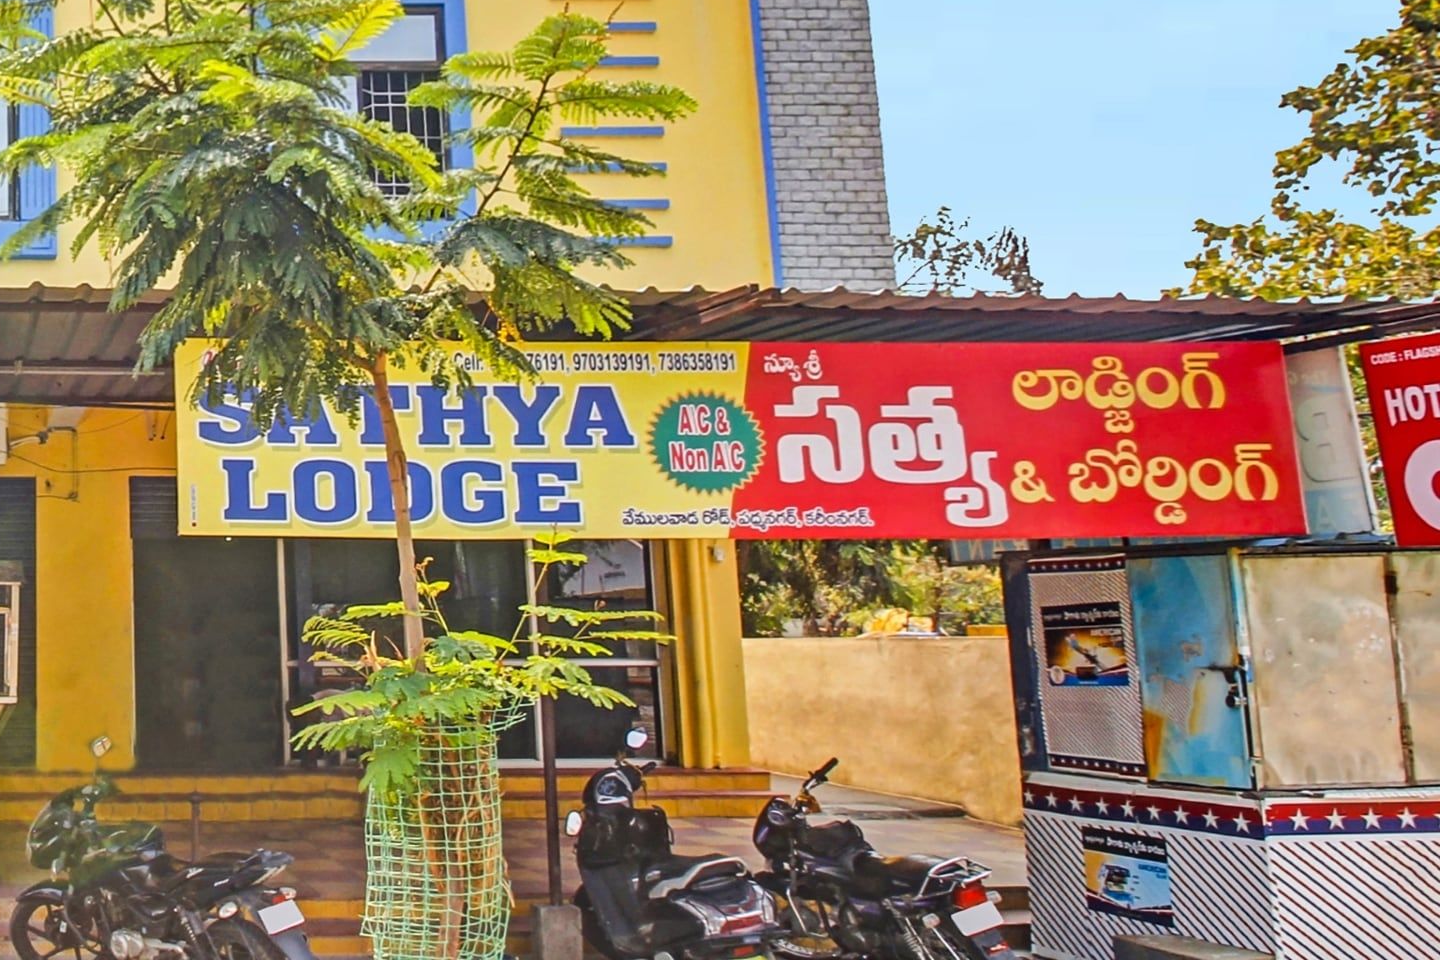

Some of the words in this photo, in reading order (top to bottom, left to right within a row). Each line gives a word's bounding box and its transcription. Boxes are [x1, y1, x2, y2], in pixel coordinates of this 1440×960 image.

[572, 352, 656, 374] 9703139191,
[658, 352, 736, 371] 7386358191
[1012, 352, 1226, 433] లాడ్జింగ్
[715, 407, 731, 435] &
[669, 442, 709, 473] Non
[773, 385, 1009, 528] సత్య
[221, 459, 582, 523] LODGE
[1011, 460, 1055, 503] &
